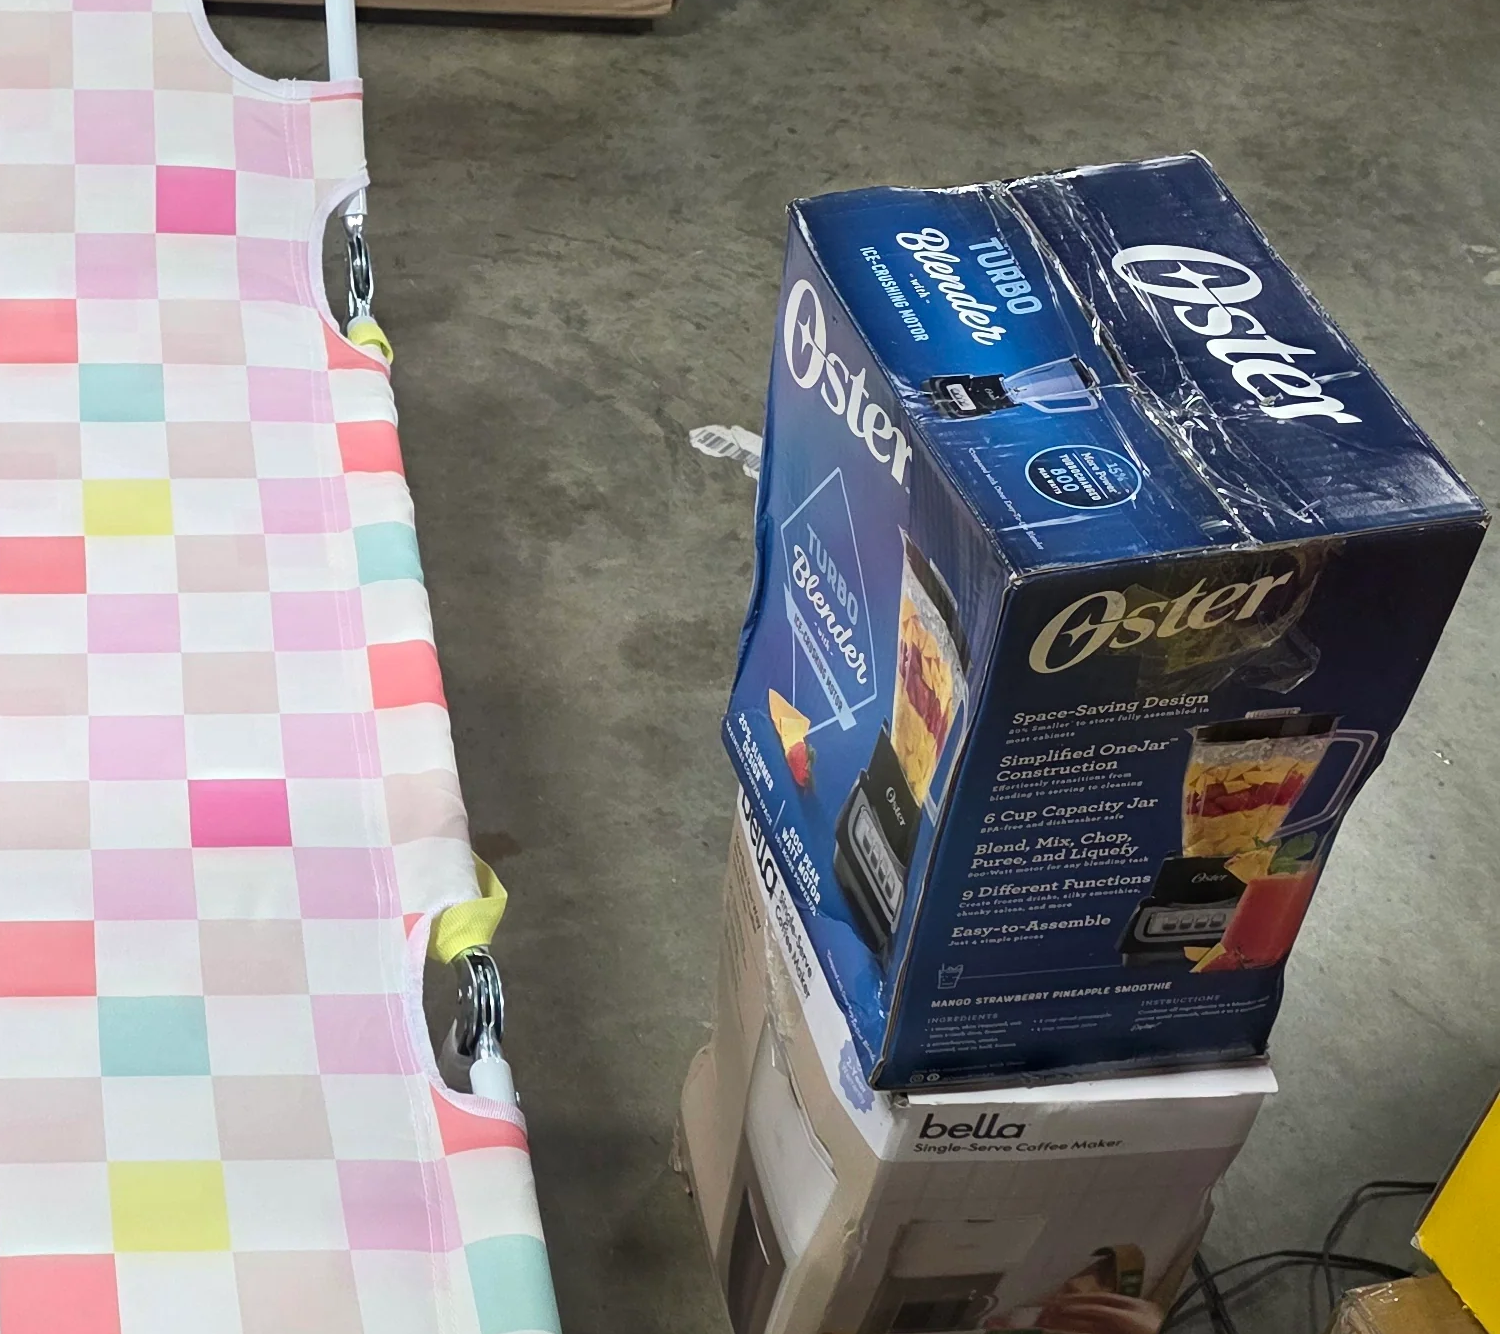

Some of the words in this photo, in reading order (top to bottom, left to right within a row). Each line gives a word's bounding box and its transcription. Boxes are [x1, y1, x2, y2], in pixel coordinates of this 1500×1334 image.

[896, 227, 1007, 346] Blender
[969, 236, 1043, 315] TURBO
[859, 246, 909, 308] ICE-CRUSHING
[899, 305, 929, 342] MOTOR
[1112, 244, 1362, 424] Oster
[784, 279, 912, 485] Oster
[1081, 452, 1097, 473] More
[1106, 462, 1130, 482] 15%
[1037, 467, 1050, 480] PEAK
[1046, 479, 1063, 495] WATTS
[1050, 468, 1080, 492] 800
[1059, 454, 1102, 501] TURBOCHARGED
[806, 523, 858, 625] TURBO
[793, 544, 867, 684] Blender
[1029, 570, 1294, 674] Oster
[794, 613, 826, 680] ICE-CRUSHING
[825, 677, 844, 713] MOTOR
[1013, 701, 1139, 725] Space-Saving
[1143, 693, 1209, 710] Design
[1075, 719, 1086, 727] to
[1089, 716, 1115, 725] store
[1117, 713, 1140, 723] fully
[1143, 707, 1196, 719] assembled
[1006, 736, 1031, 745] most
[1035, 731, 1075, 742] cabinets
[738, 713, 752, 743] 20%
[751, 742, 774, 791] SLIMMER
[742, 740, 762, 782] DESIGN
[1000, 745, 1094, 769] Simplified
[726, 720, 745, 765] MAXIMIZES
[743, 761, 761, 803] COUNTER
[759, 798, 773, 826] SPACE
[992, 780, 1049, 793] Effortlessly
[1051, 774, 1106, 786] transitions
[1108, 772, 1132, 780] from
[996, 759, 1118, 782] Construction
[989, 791, 1032, 802] blending
[1035, 789, 1046, 797] to
[1048, 785, 1085, 796] serving
[1087, 783, 1098, 791] to
[1100, 779, 1143, 791] cleaning
[885, 786, 906, 827] Oster
[984, 813, 996, 824] 6
[1000, 809, 1038, 824] Cup
[1042, 800, 1124, 821] Capacity
[1127, 796, 1159, 810] Jar
[980, 823, 1024, 834] BPA-free
[1025, 820, 1044, 829] and
[1046, 815, 1102, 827] dishwasher
[1103, 813, 1124, 821] safe
[789, 826, 804, 854] 800
[802, 852, 821, 887] PEAK
[970, 855, 1027, 869] Puree,
[1031, 848, 1068, 864] and
[1070, 843, 1140, 861] Liquefy
[974, 839, 1031, 856] Blend,
[1034, 836, 1075, 850] Mix,
[1080, 832, 1133, 847] Chop,
[781, 848, 797, 874] MORE
[781, 827, 799, 861] WATT
[797, 862, 821, 905] MOTOR
[967, 868, 1013, 879] 800-Watt
[1015, 865, 1045, 874] motor
[1046, 862, 1061, 871] for
[1064, 861, 1081, 870] any
[1083, 857, 1127, 869] blending
[1129, 855, 1149, 864] task
[959, 898, 991, 909] Create
[993, 895, 1024, 906] frozen
[1026, 892, 1060, 903] drinks,
[1063, 891, 1087, 901] silky
[1089, 887, 1141, 897] smoothies,
[961, 889, 975, 902] 9
[977, 882, 1059, 899] Different
[1062, 873, 1151, 891] Functions
[956, 908, 991, 918] chunky
[1028, 903, 1046, 912] and
[1048, 901, 1073, 909] more
[779, 889, 813, 981] Single-Serve
[951, 914, 1111, 938] Easy-to-Assemble
[775, 905, 793, 954] Coffee
[792, 949, 811, 1000] Maker
[948, 938, 969, 947] Just
[980, 936, 1012, 946] simple
[1013, 933, 1044, 943] pieces
[931, 997, 972, 1008] MANGO
[975, 992, 1049, 1005] STRAWBERRY
[1052, 986, 1111, 999] PINEAPPLE
[1114, 981, 1173, 994] SMOOTHIE
[1141, 995, 1220, 1007] INSTRUCTIONS
[927, 1013, 999, 1024] INGREDIENTS
[919, 1113, 1026, 1139] bella
[913, 1142, 1012, 1155] Single-Serve
[1015, 1142, 1068, 1153] Coffee
[1070, 1139, 1124, 1150] Maker
